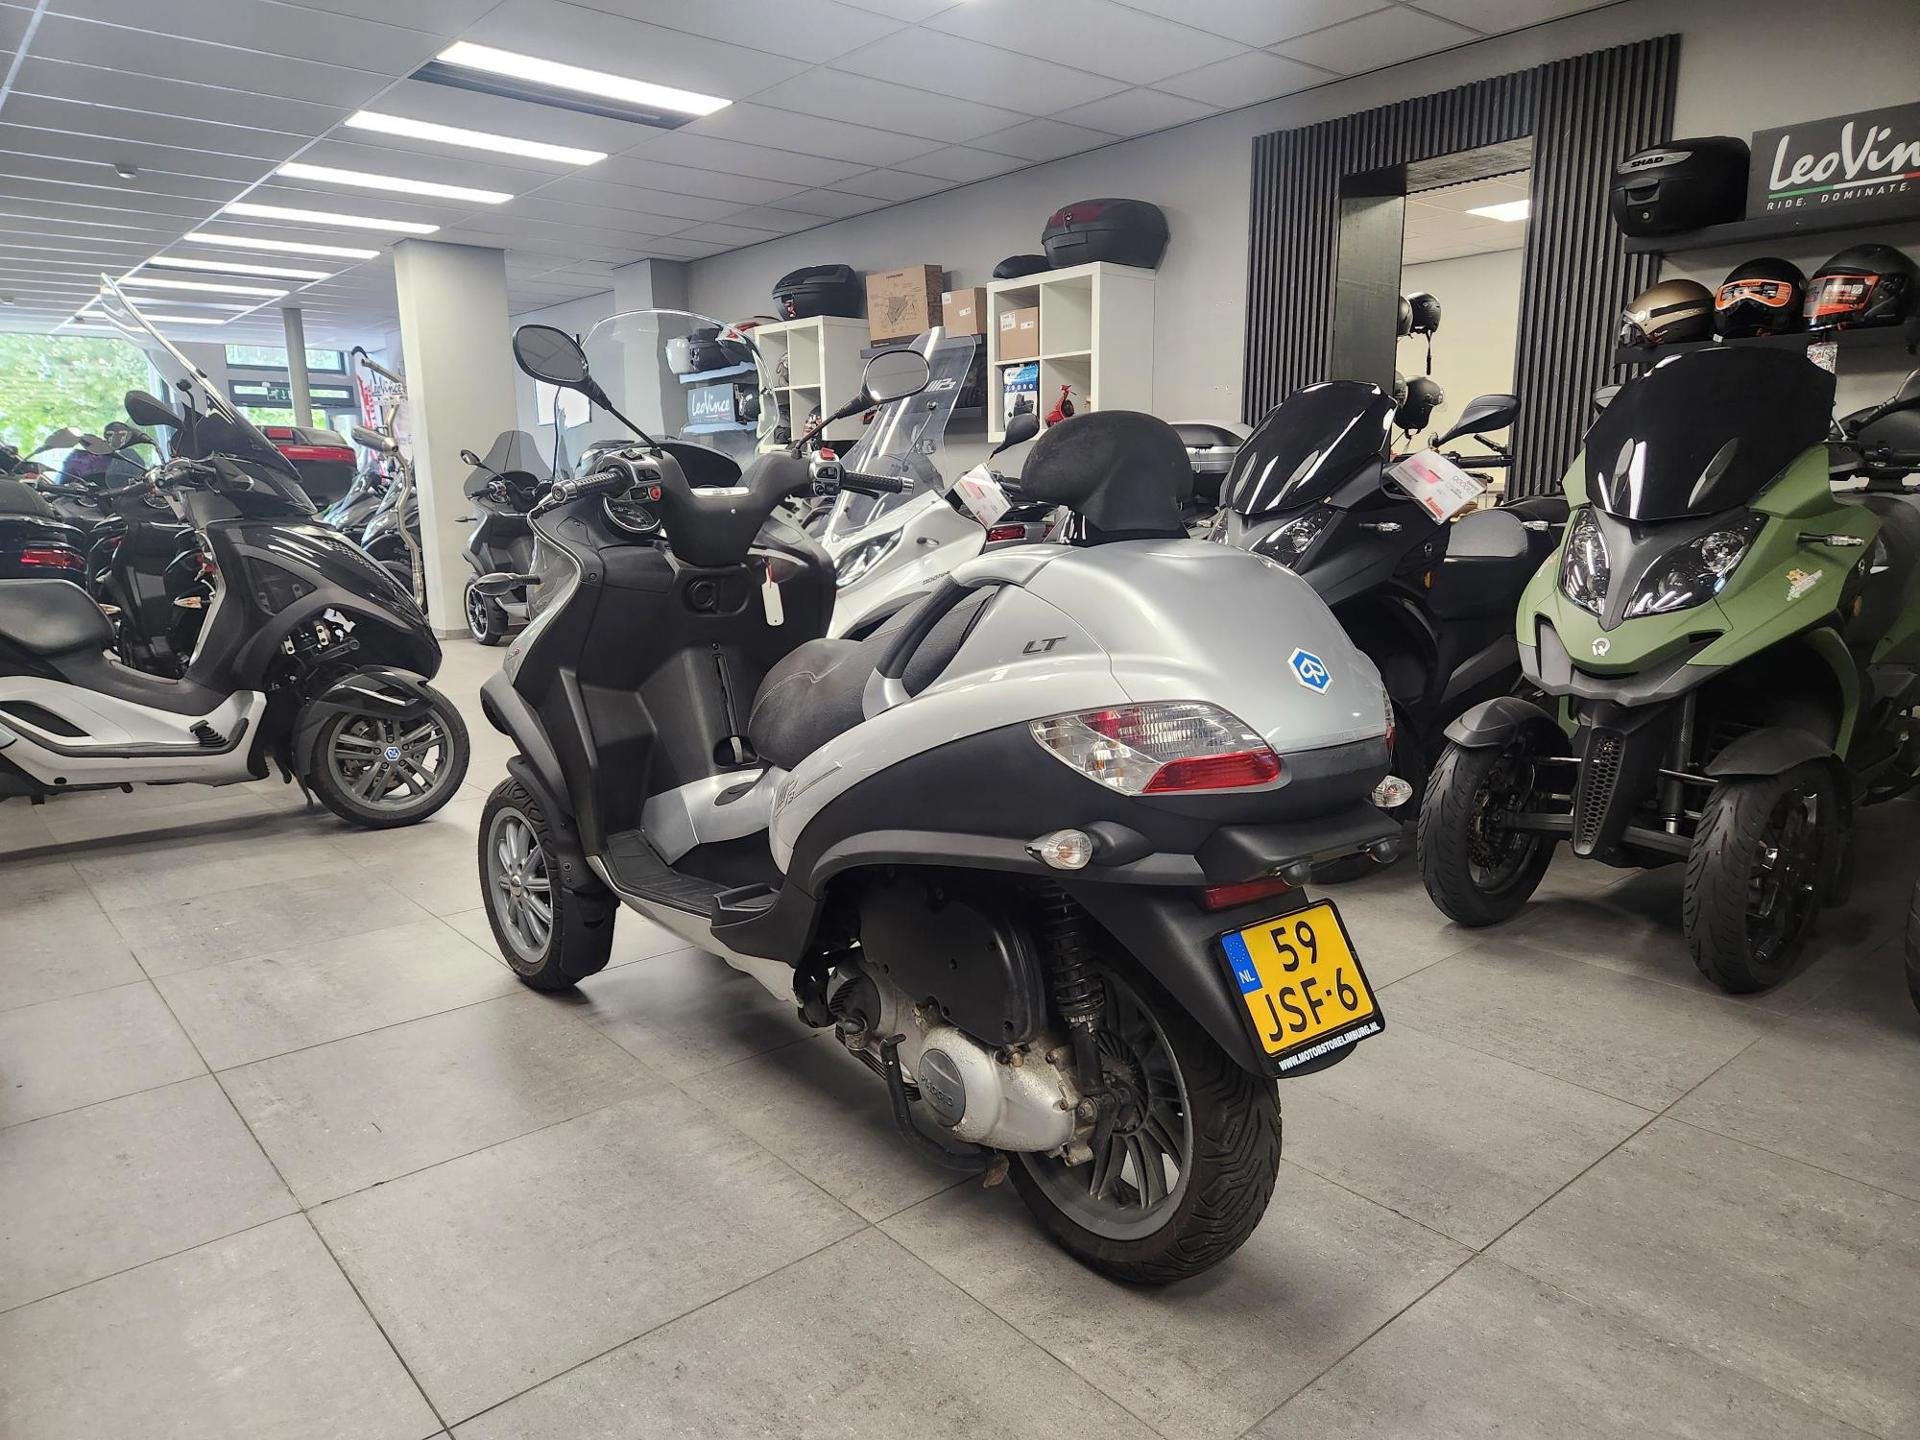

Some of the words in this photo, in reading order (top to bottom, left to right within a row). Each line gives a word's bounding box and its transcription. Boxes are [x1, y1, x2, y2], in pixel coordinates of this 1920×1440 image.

[1631, 156, 1665, 168] SHAD
[1022, 636, 1068, 654] LT
[1270, 920, 1319, 972] 59
[1238, 969, 1256, 984] NL
